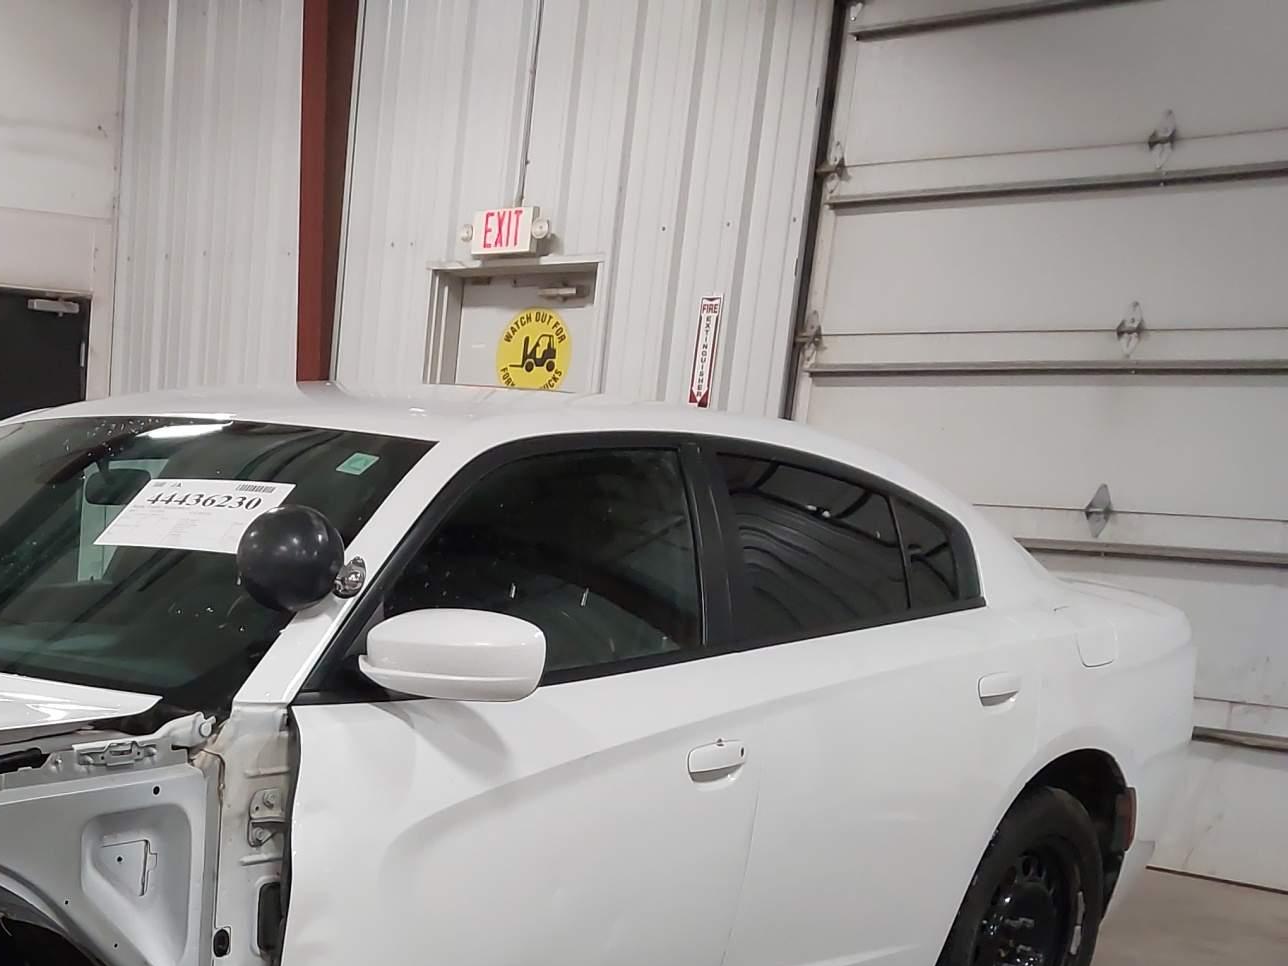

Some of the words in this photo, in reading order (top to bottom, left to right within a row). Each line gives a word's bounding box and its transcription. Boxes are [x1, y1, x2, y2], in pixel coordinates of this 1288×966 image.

[483, 209, 523, 249] EXIT
[702, 303, 719, 314] FIRE
[504, 313, 532, 342] WATCH
[535, 311, 553, 325] OUT
[552, 321, 567, 343] FOR
[696, 315, 712, 397] EXTINGUISHER
[146, 492, 263, 511] 44436230
